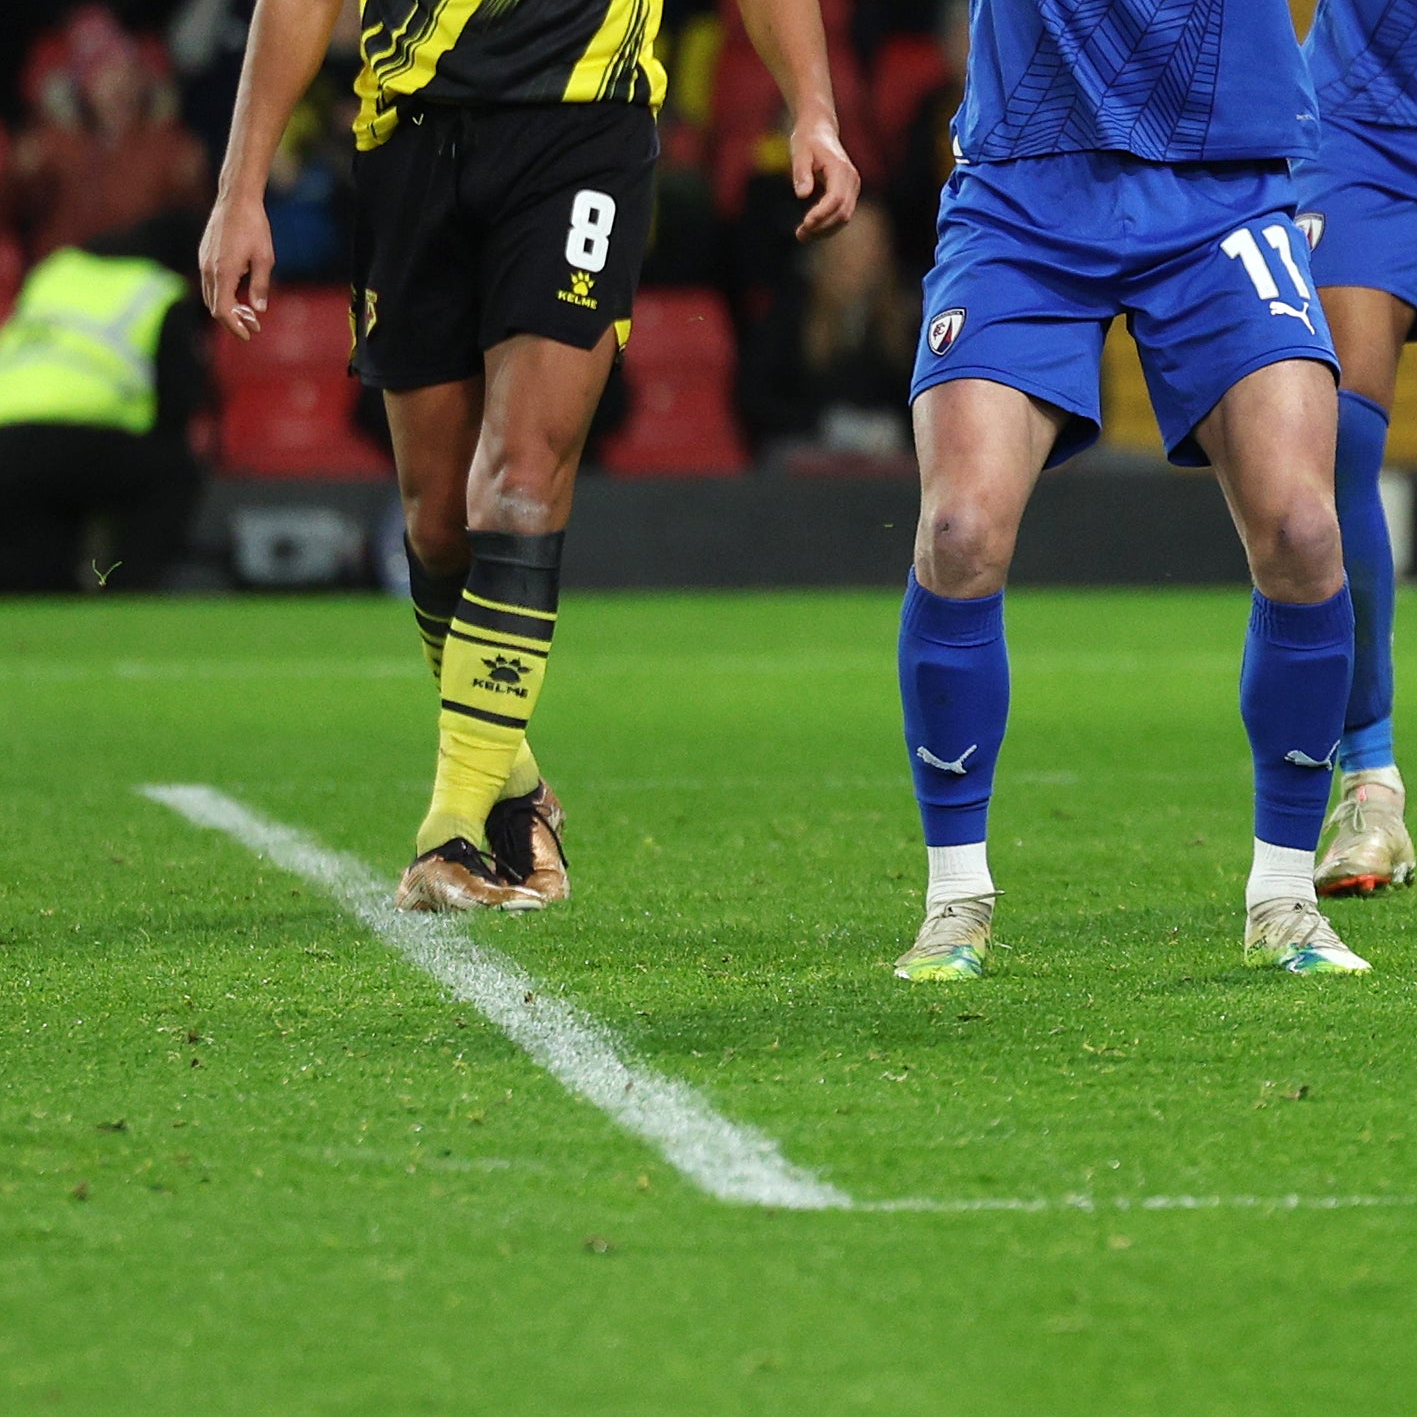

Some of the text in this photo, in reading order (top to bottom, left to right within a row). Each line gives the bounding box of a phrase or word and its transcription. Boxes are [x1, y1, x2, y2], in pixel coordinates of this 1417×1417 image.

[565, 188, 617, 273] 8
[1219, 224, 1312, 301] 11
[556, 288, 599, 311] KELME
[472, 677, 529, 699] KELME
